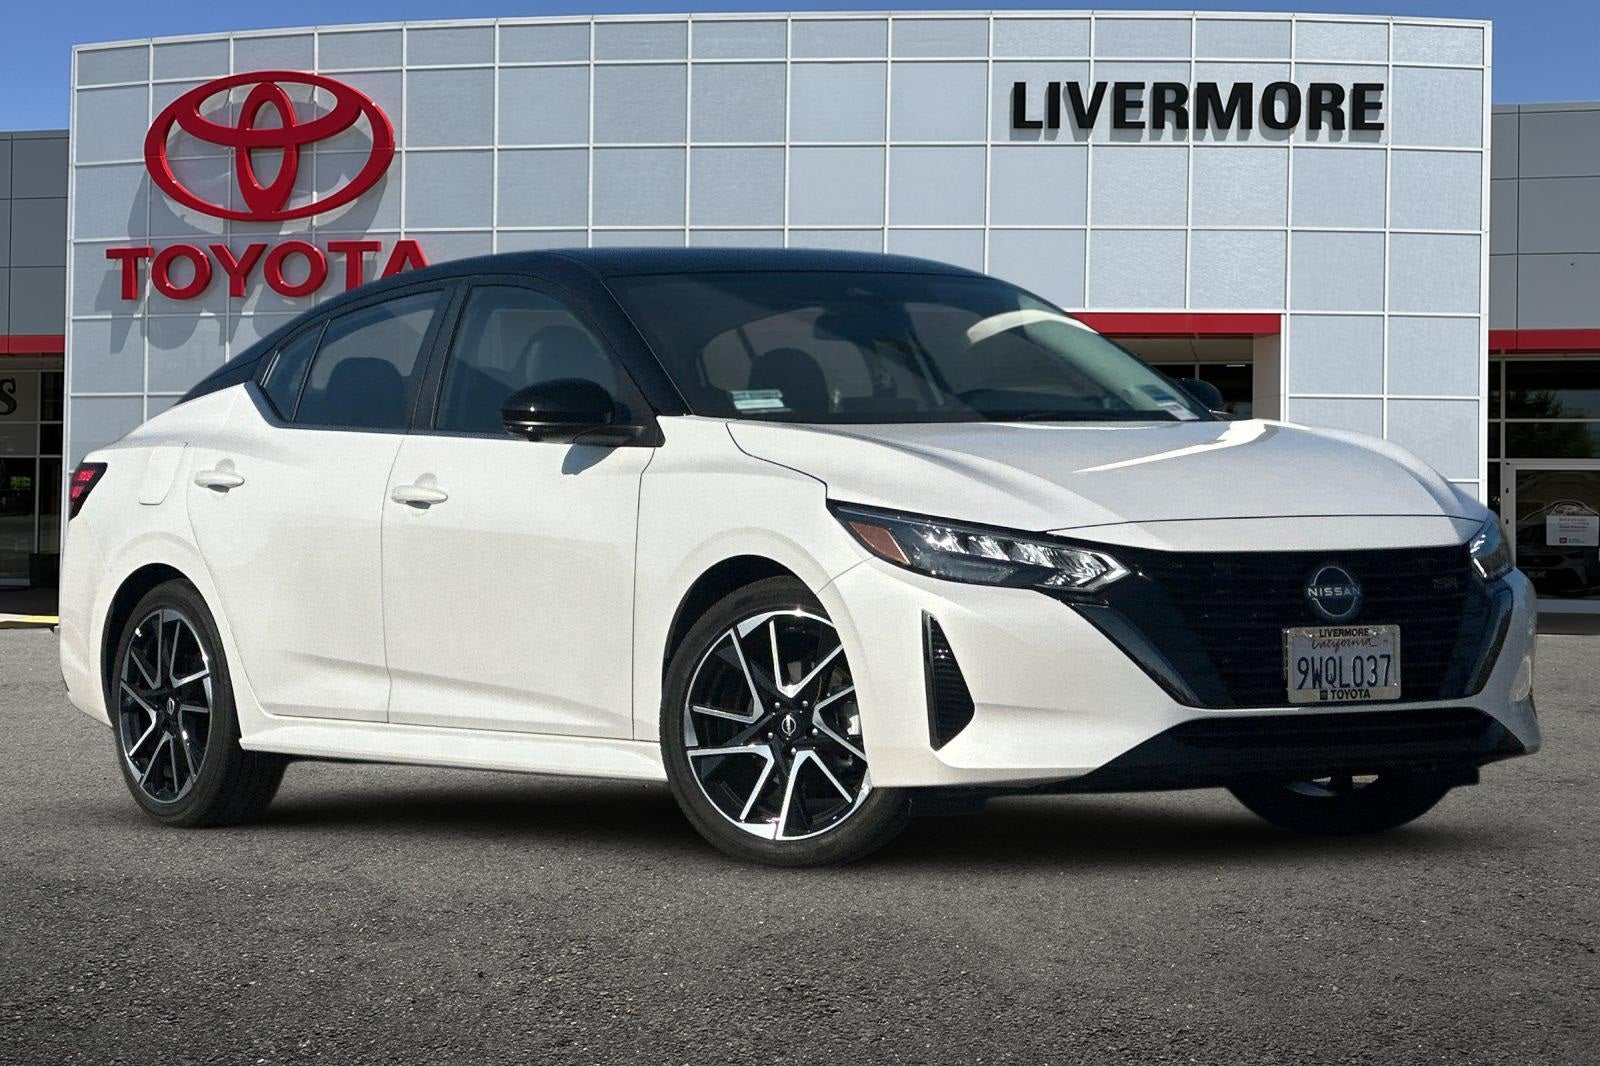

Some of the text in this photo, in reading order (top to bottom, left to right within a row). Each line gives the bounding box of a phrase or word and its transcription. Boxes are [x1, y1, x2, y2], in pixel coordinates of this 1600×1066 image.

[1012, 81, 1385, 131] LIVERMORE
[1307, 585, 1361, 597] NISSAN
[1319, 628, 1370, 638] LIVERMORE
[1311, 637, 1377, 653] California
[1296, 654, 1392, 690] 9WQL037
[1330, 688, 1371, 700] TOYOTA
